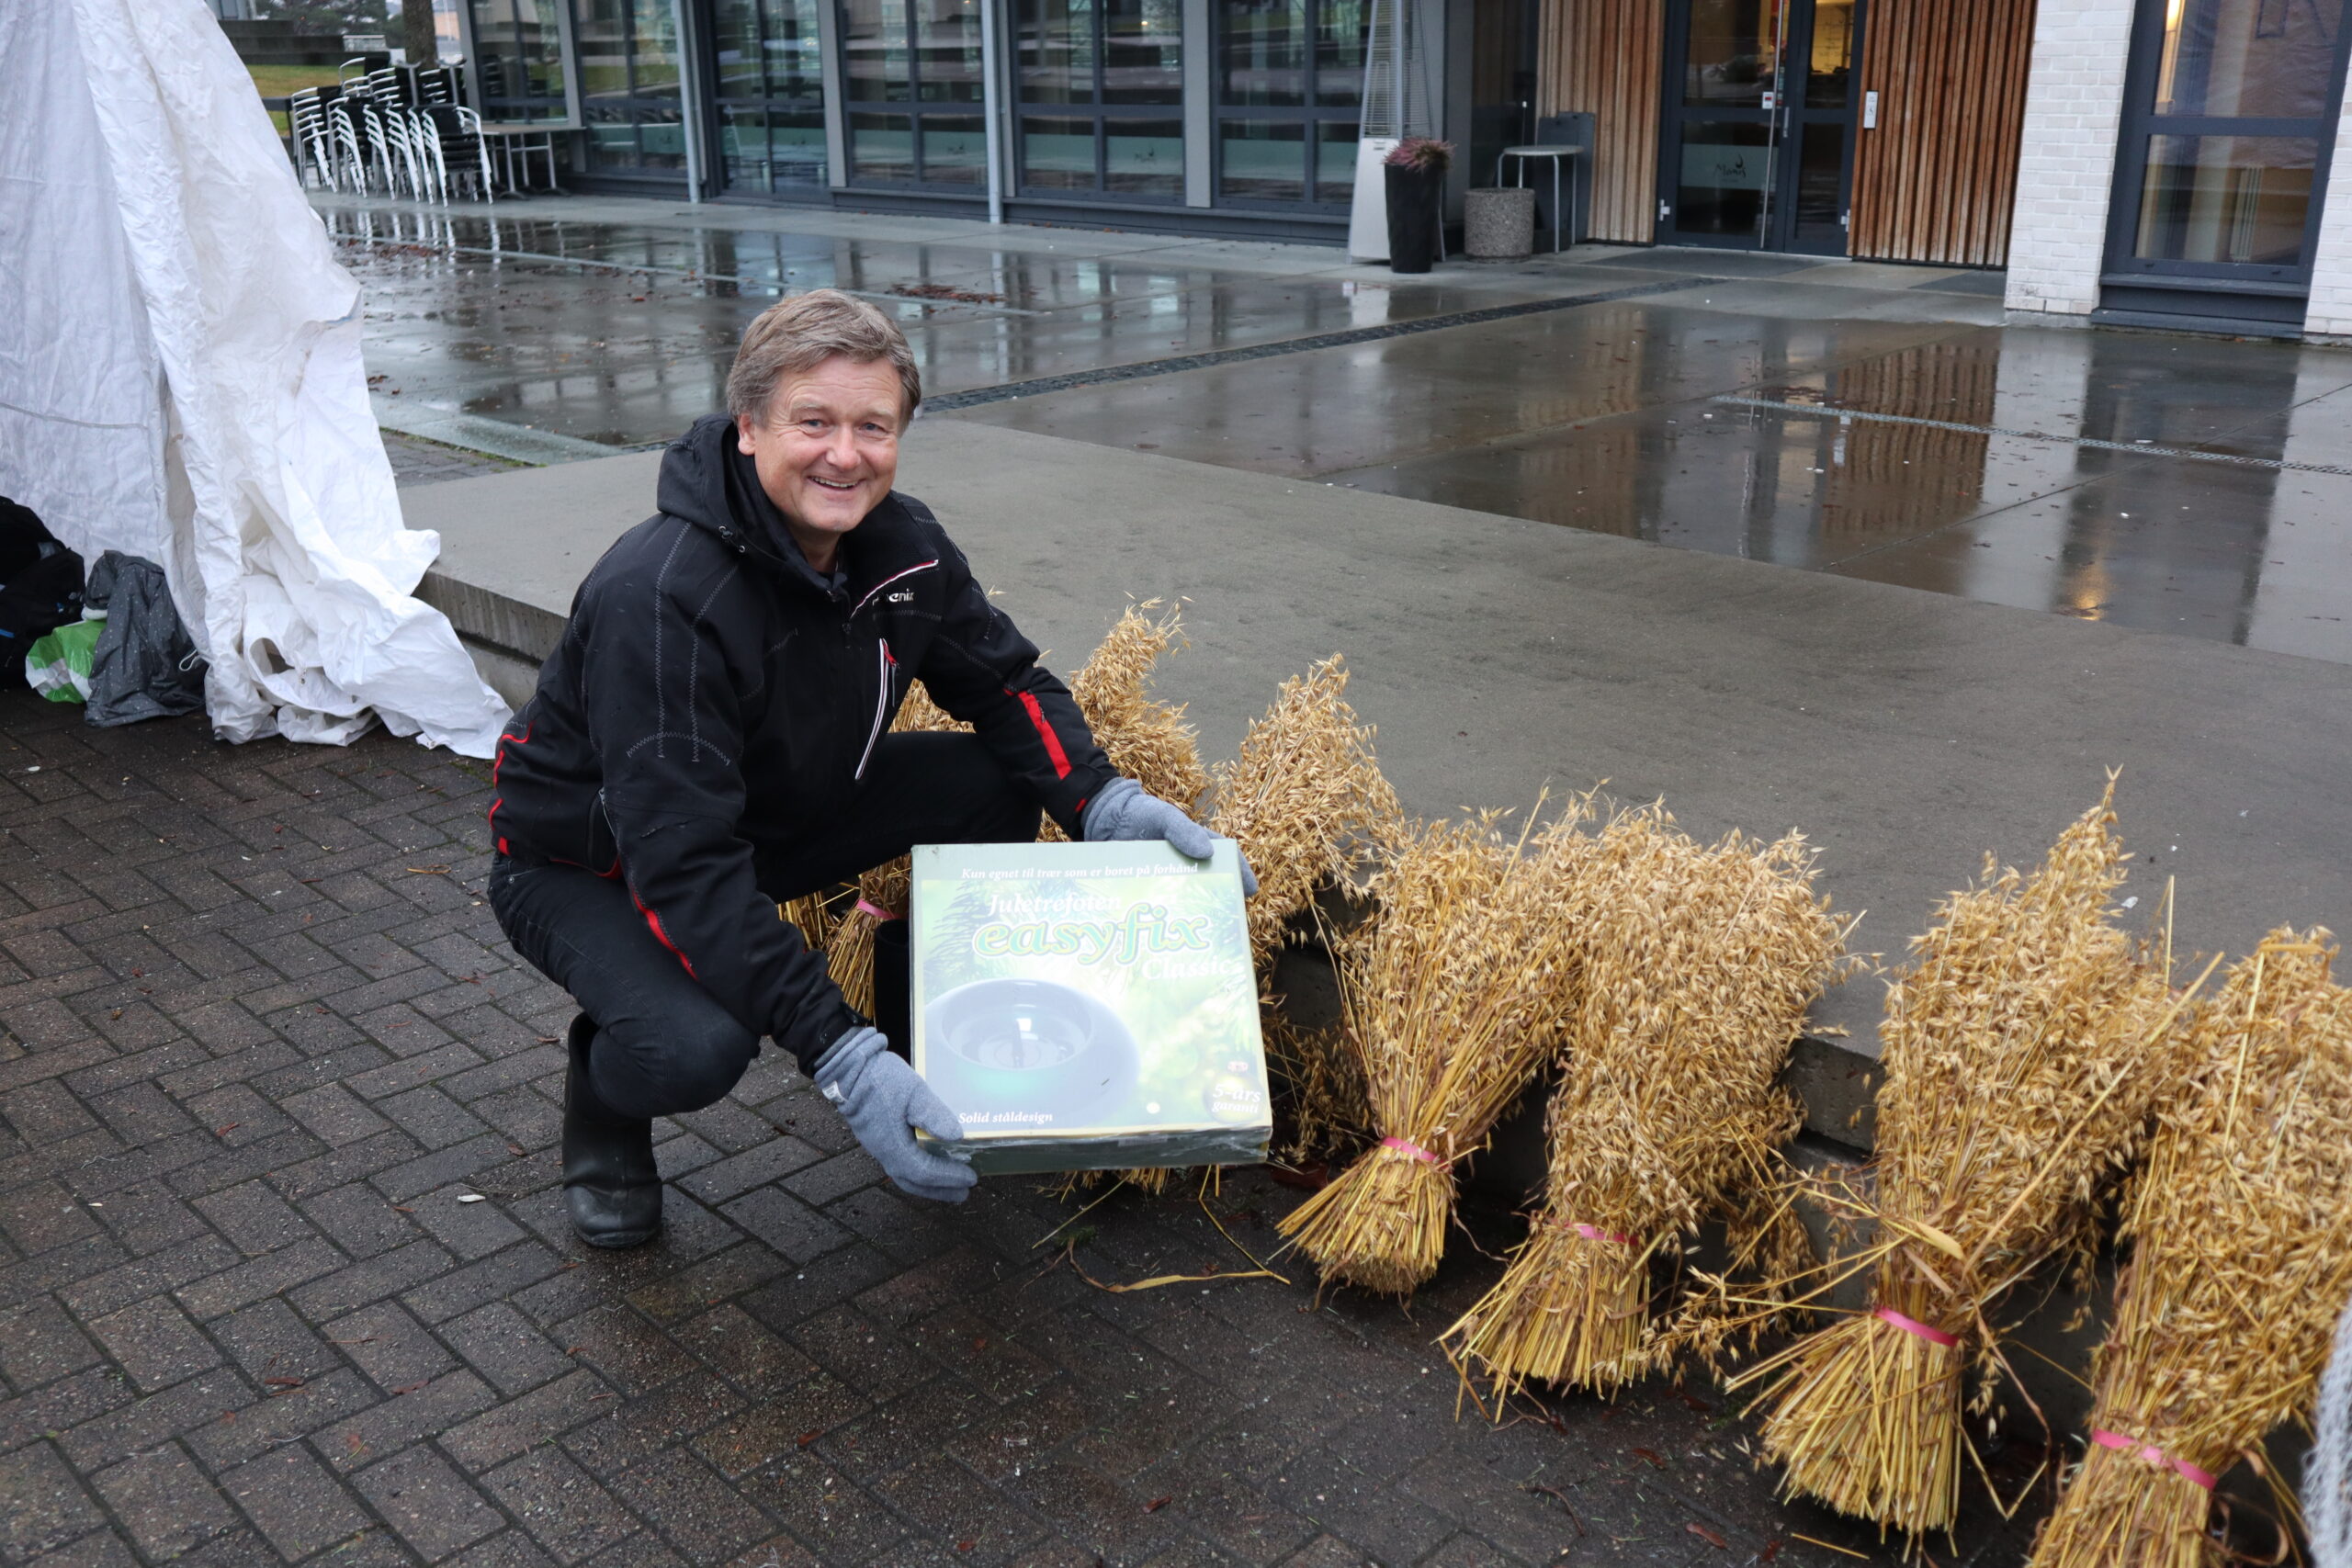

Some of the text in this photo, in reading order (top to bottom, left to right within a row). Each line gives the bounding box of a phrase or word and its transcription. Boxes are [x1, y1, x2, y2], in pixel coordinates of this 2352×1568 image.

[961, 863, 1199, 881] Kun egnet til trær som er boret på forhånd
[987, 892, 1122, 918] Juletrefoten
[974, 901, 1211, 965] easyfix
[1142, 954, 1232, 980] Classic
[958, 1111, 1054, 1125] Solid ståldesign
[1211, 1101, 1260, 1114] garanti
